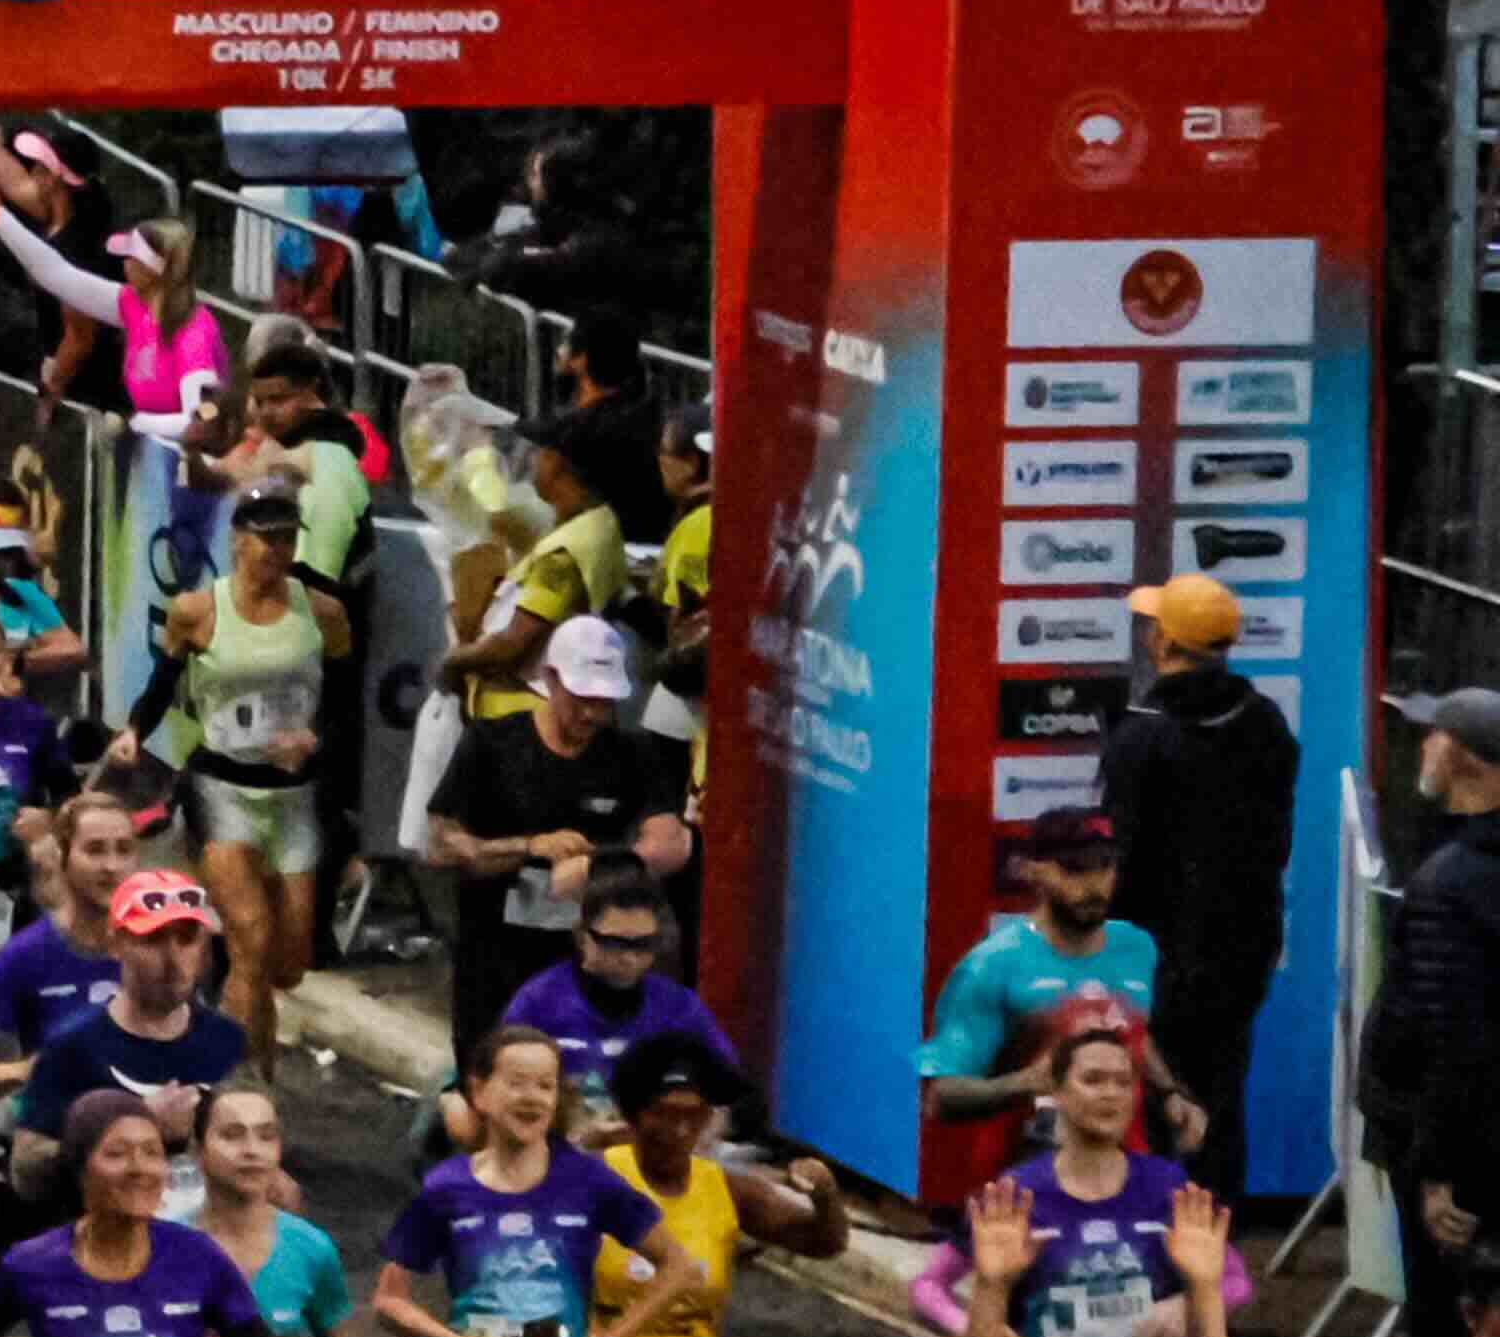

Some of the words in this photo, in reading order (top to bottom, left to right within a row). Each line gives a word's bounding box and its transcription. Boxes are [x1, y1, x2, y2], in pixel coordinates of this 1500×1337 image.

[172, 12, 333, 35] MASCULINO
[364, 11, 499, 33] FEMININO
[211, 40, 340, 63] CHEGADA
[372, 38, 460, 61] FINISH
[277, 68, 329, 90] 10K
[361, 68, 396, 90] 5K
